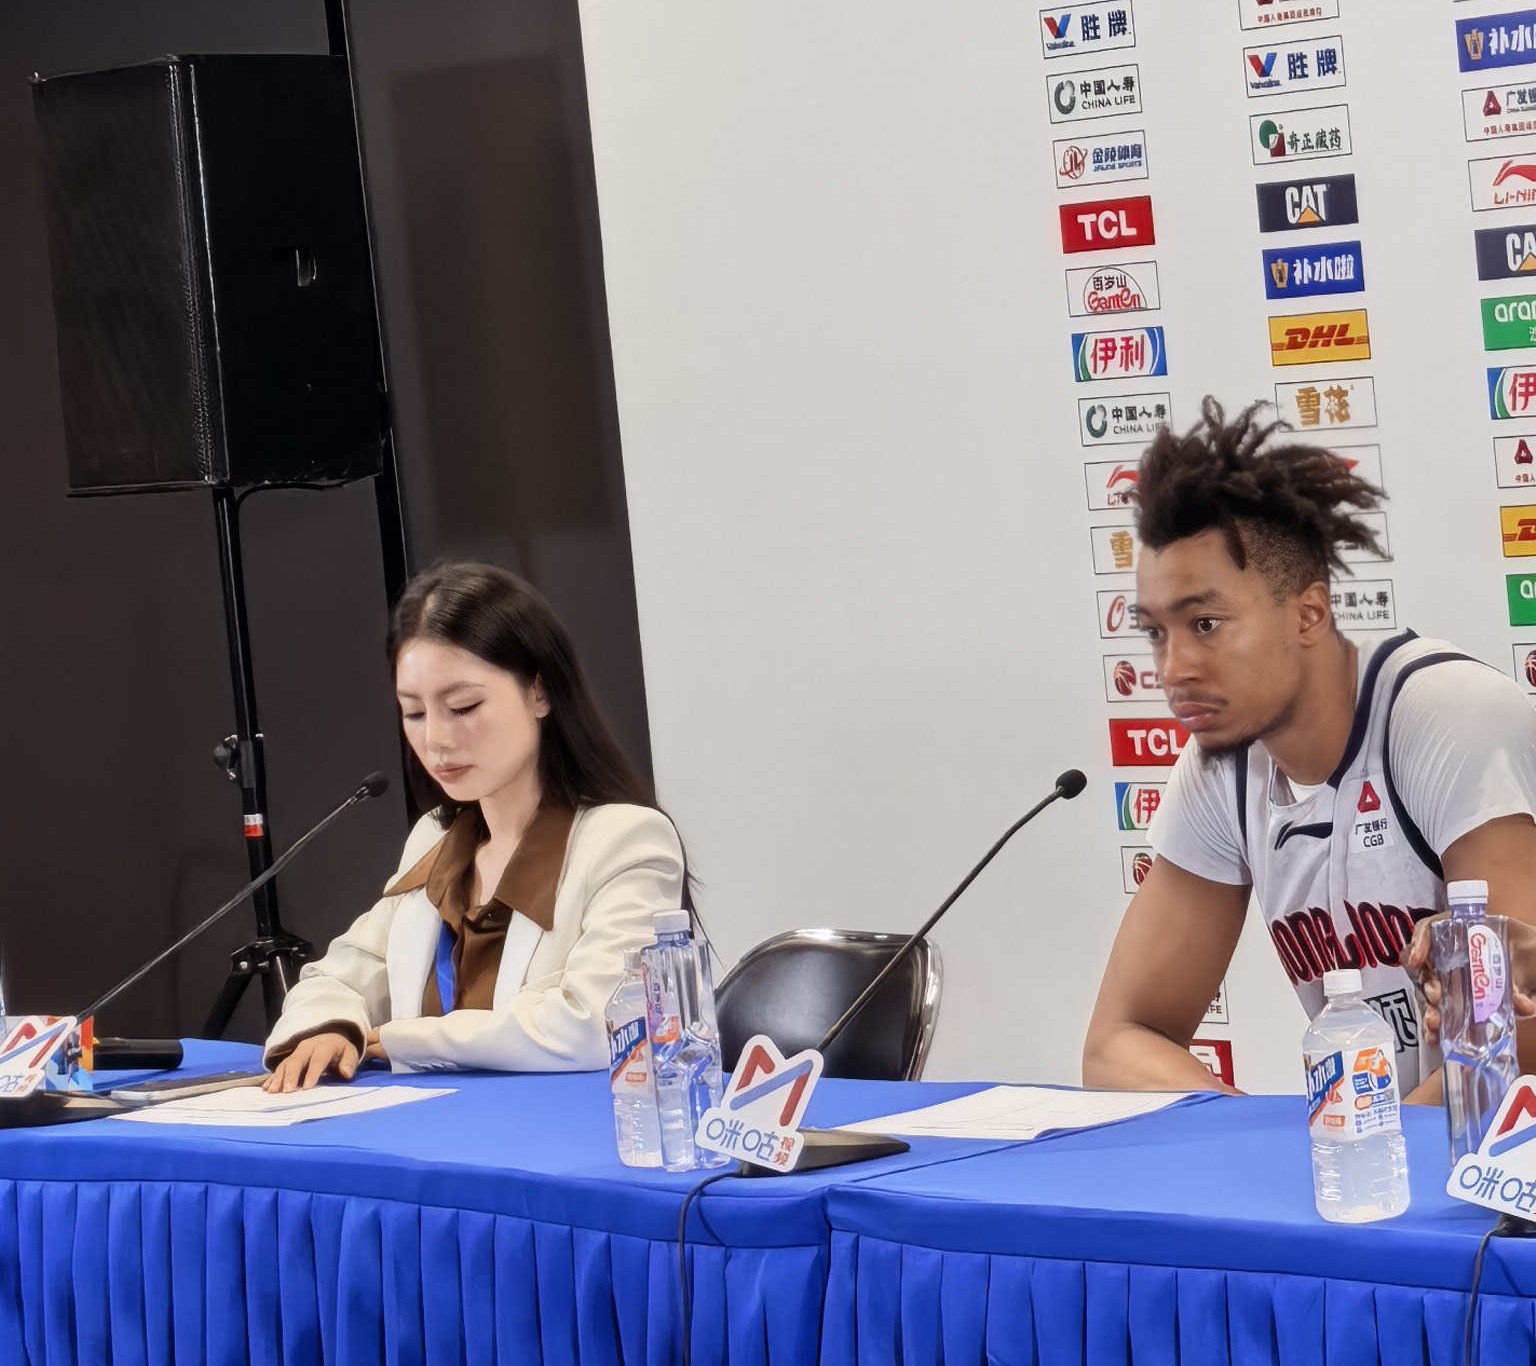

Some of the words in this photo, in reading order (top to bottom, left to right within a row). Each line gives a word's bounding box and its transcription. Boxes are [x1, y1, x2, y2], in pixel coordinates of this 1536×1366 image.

[1080, 76, 1135, 98] 中国人寿
[1081, 97, 1112, 110] CHINA
[1115, 94, 1136, 107] LIFE
[1285, 185, 1328, 224] CAT
[1077, 209, 1137, 241] TCL
[1293, 254, 1354, 285] 补水啦
[1092, 274, 1127, 291] 百岁山
[1284, 324, 1355, 351] DHL
[1090, 334, 1145, 374] 伊利
[1112, 404, 1166, 423] 中国人寿
[1295, 386, 1351, 426] 雪花
[1113, 424, 1143, 435] CHINA
[1367, 609, 1390, 621] LIFE
[1363, 834, 1385, 848] CGB
